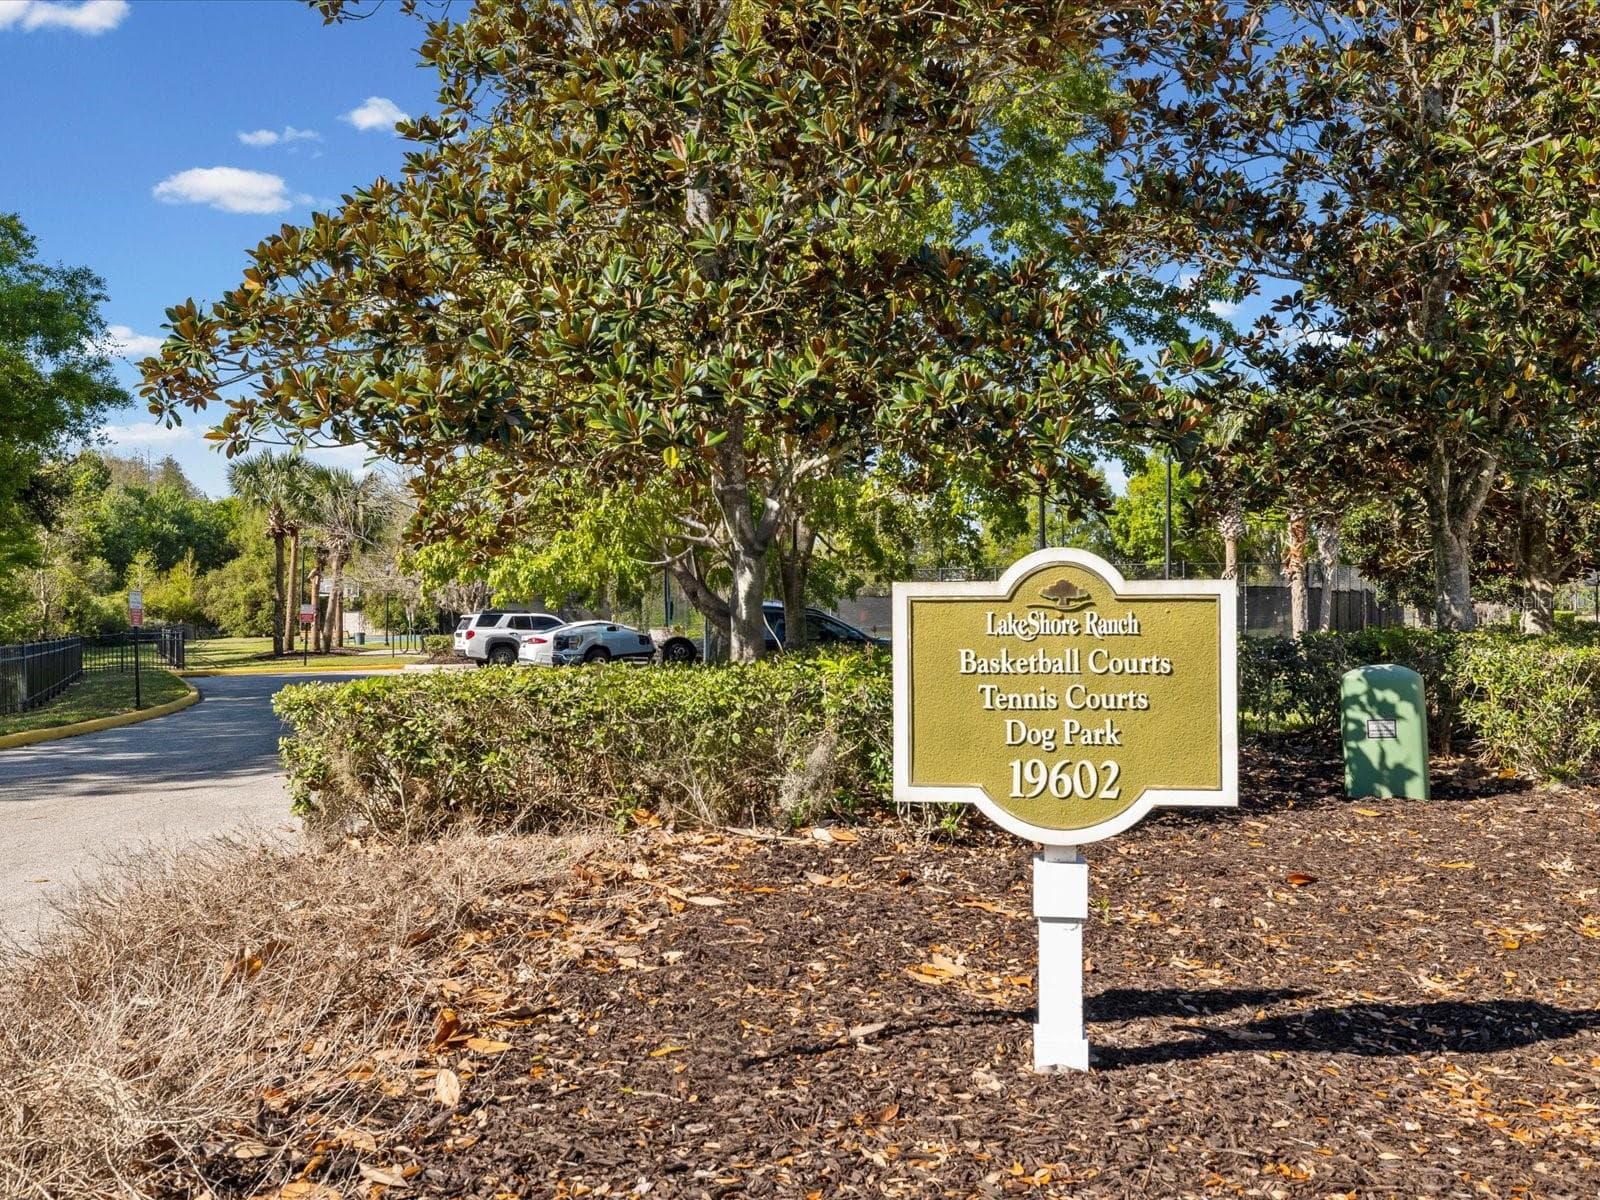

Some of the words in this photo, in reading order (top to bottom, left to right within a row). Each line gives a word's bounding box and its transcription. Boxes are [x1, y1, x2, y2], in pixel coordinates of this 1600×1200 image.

[986, 611, 1080, 641] LakeShore
[1084, 612, 1139, 638] Ranch
[959, 648, 1080, 674] Basketball
[1089, 649, 1171, 674] Courts
[978, 685, 1057, 709] Tennis
[1066, 684, 1148, 709] Courts
[1005, 720, 1055, 750] Dog
[1063, 719, 1120, 745] Park
[1010, 759, 1120, 799] 19602
